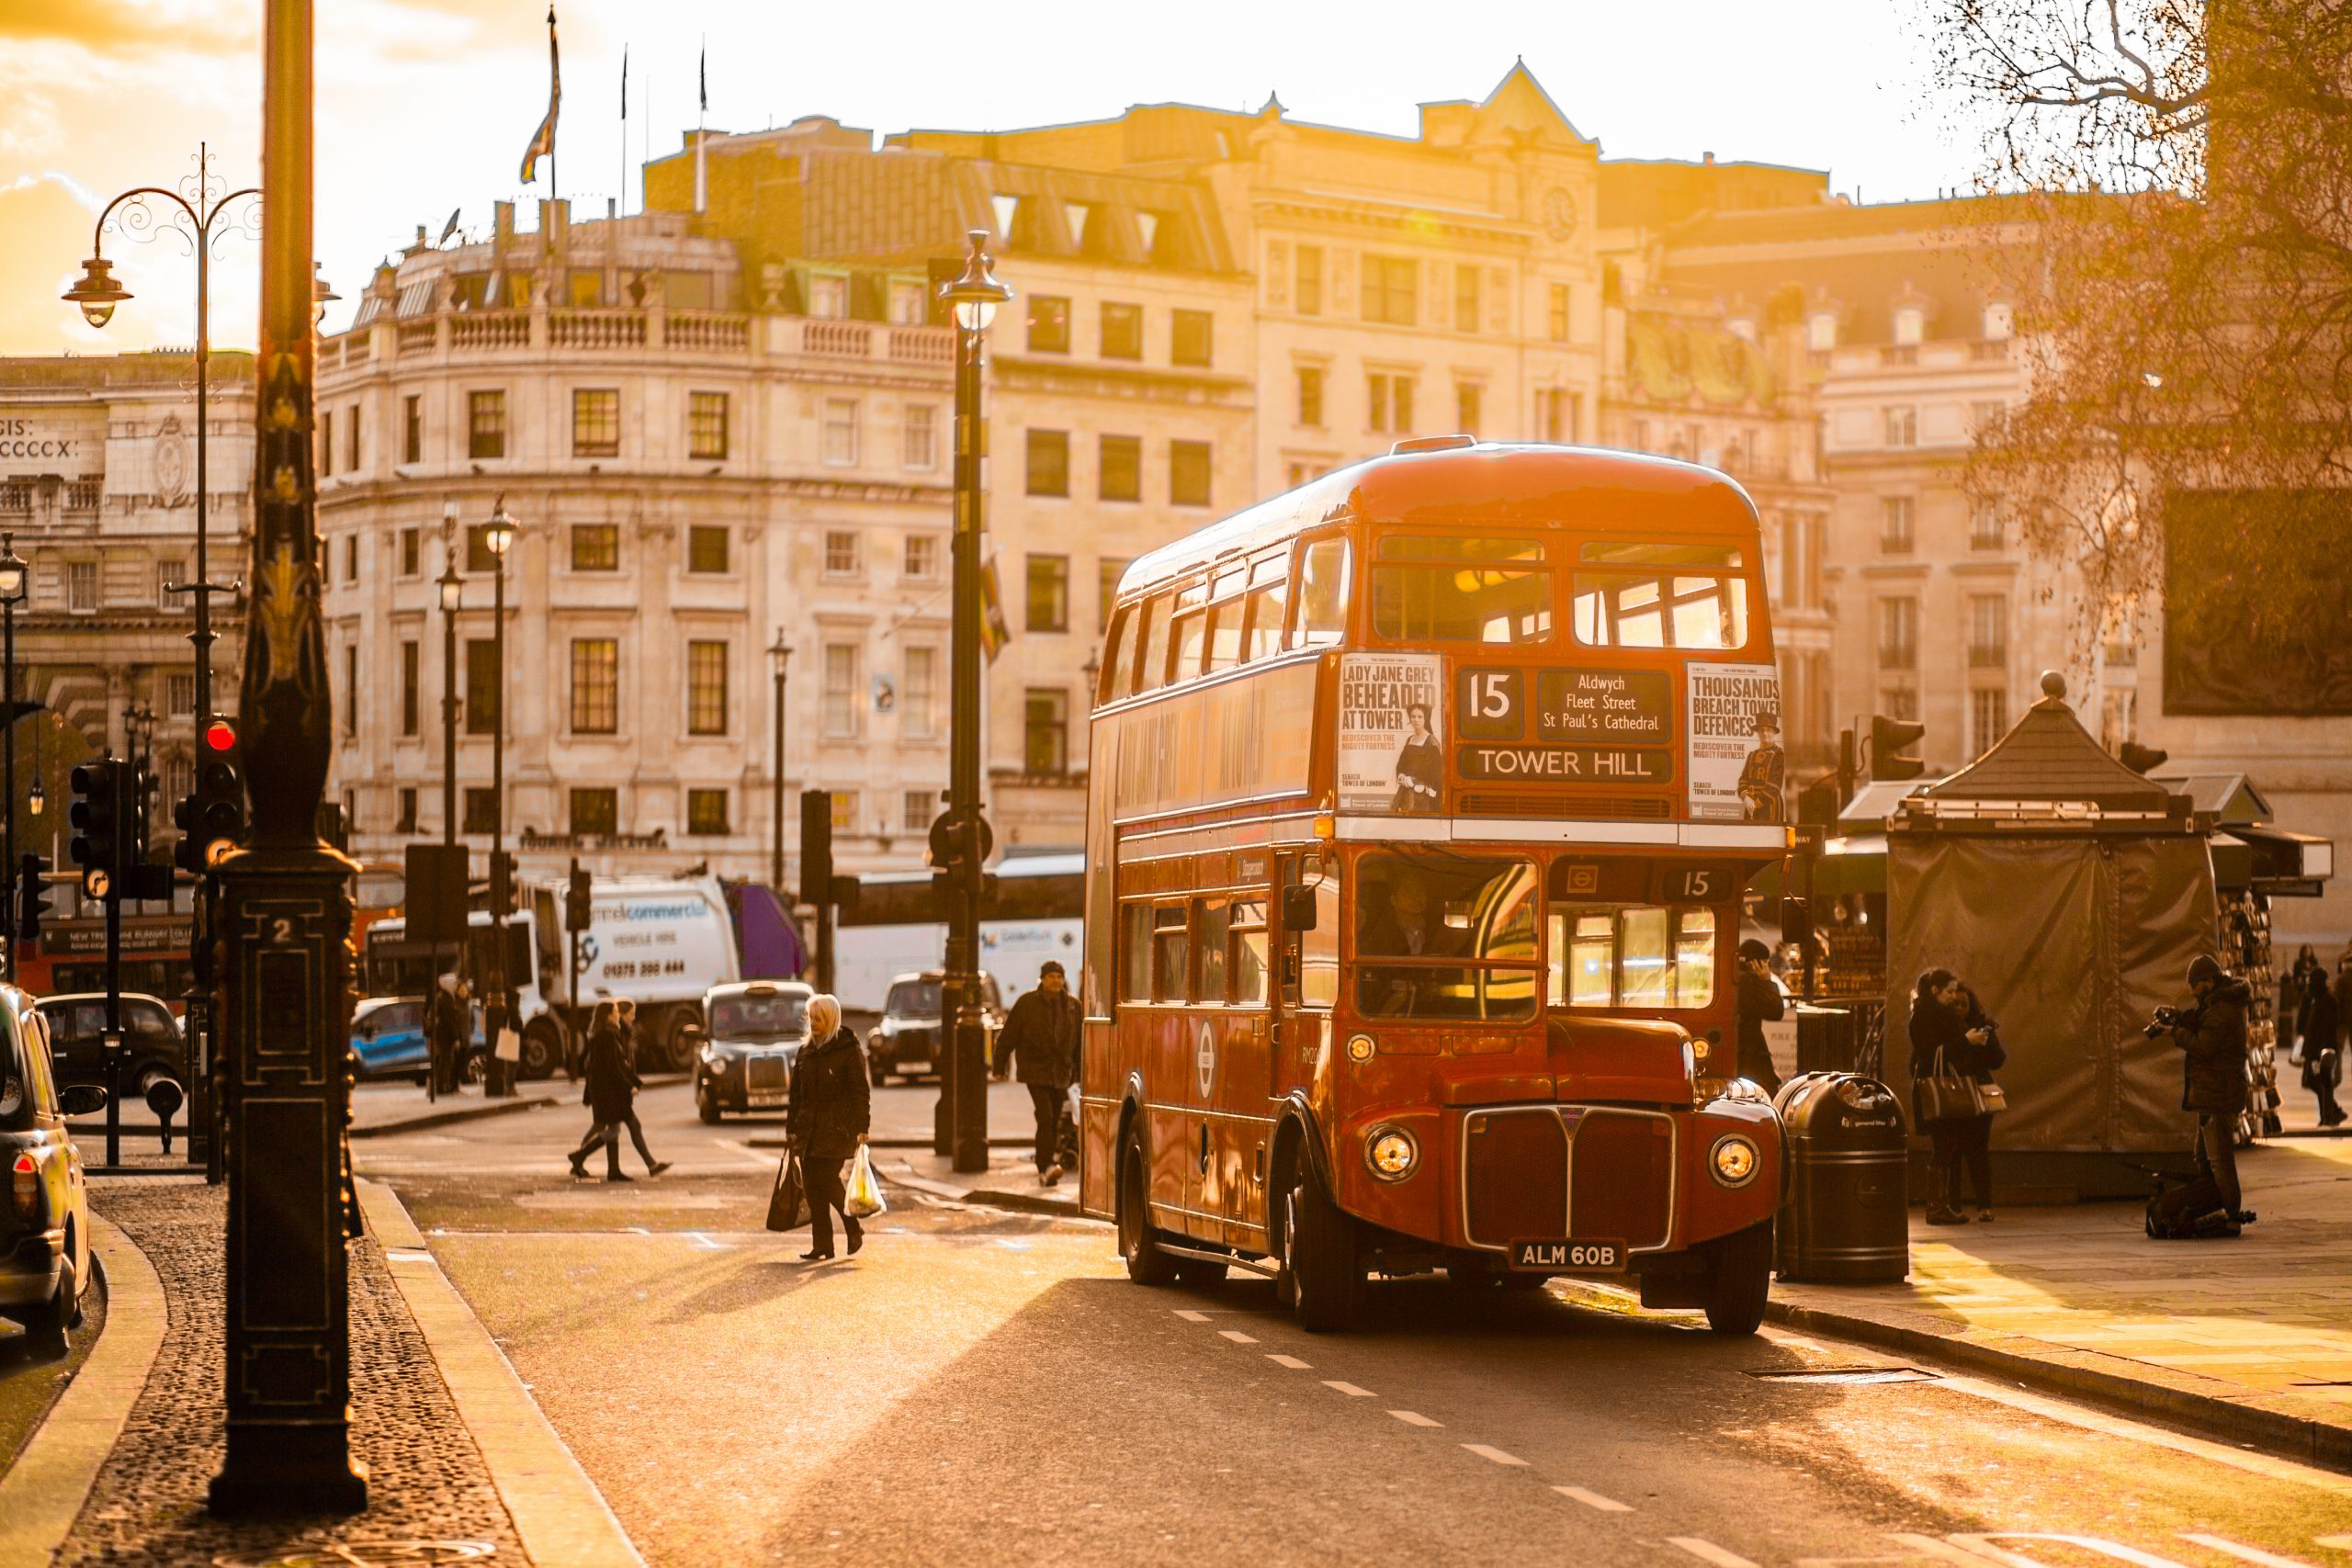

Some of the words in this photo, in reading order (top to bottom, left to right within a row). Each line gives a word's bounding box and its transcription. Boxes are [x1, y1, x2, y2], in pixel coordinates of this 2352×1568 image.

[1342, 665, 1371, 682] LADY
[1373, 666, 1403, 682] JANE
[1405, 666, 1435, 682] GREY
[1578, 674, 1625, 694] Aldwych
[1692, 676, 1780, 700] THOUSANDS
[1342, 682, 1436, 709] BEHEADED
[1471, 673, 1510, 718] 15
[1566, 694, 1595, 709] Fleet
[1602, 694, 1636, 710] Street
[1693, 697, 1740, 716] BREACH
[1742, 699, 1781, 718] TOWER
[1341, 710, 1357, 730] AT
[1358, 710, 1403, 730] TOWER
[1544, 712, 1556, 728] St
[1563, 713, 1599, 728] Paul's
[1605, 714, 1659, 730] Cathedral
[1693, 715, 1755, 737] DEFENCES
[1341, 734, 1382, 742] REDISCOVER
[1384, 734, 1396, 742] THE
[1366, 742, 1396, 750] FORTRESS
[1693, 742, 1733, 751] REDISCOVER
[1733, 743, 1746, 751] THE
[1478, 750, 1581, 775] TOWER
[1594, 752, 1652, 776] HILL
[1693, 750, 1716, 759] MIGHTY
[1716, 751, 1746, 760] FORTRESS
[1242, 859, 1264, 882] Stagecoach
[1684, 871, 1711, 897] 15
[274, 919, 291, 943] 2
[1855, 1120, 1875, 1128] general
[1521, 1245, 1566, 1264] ALM
[1570, 1246, 1615, 1265] 60B
